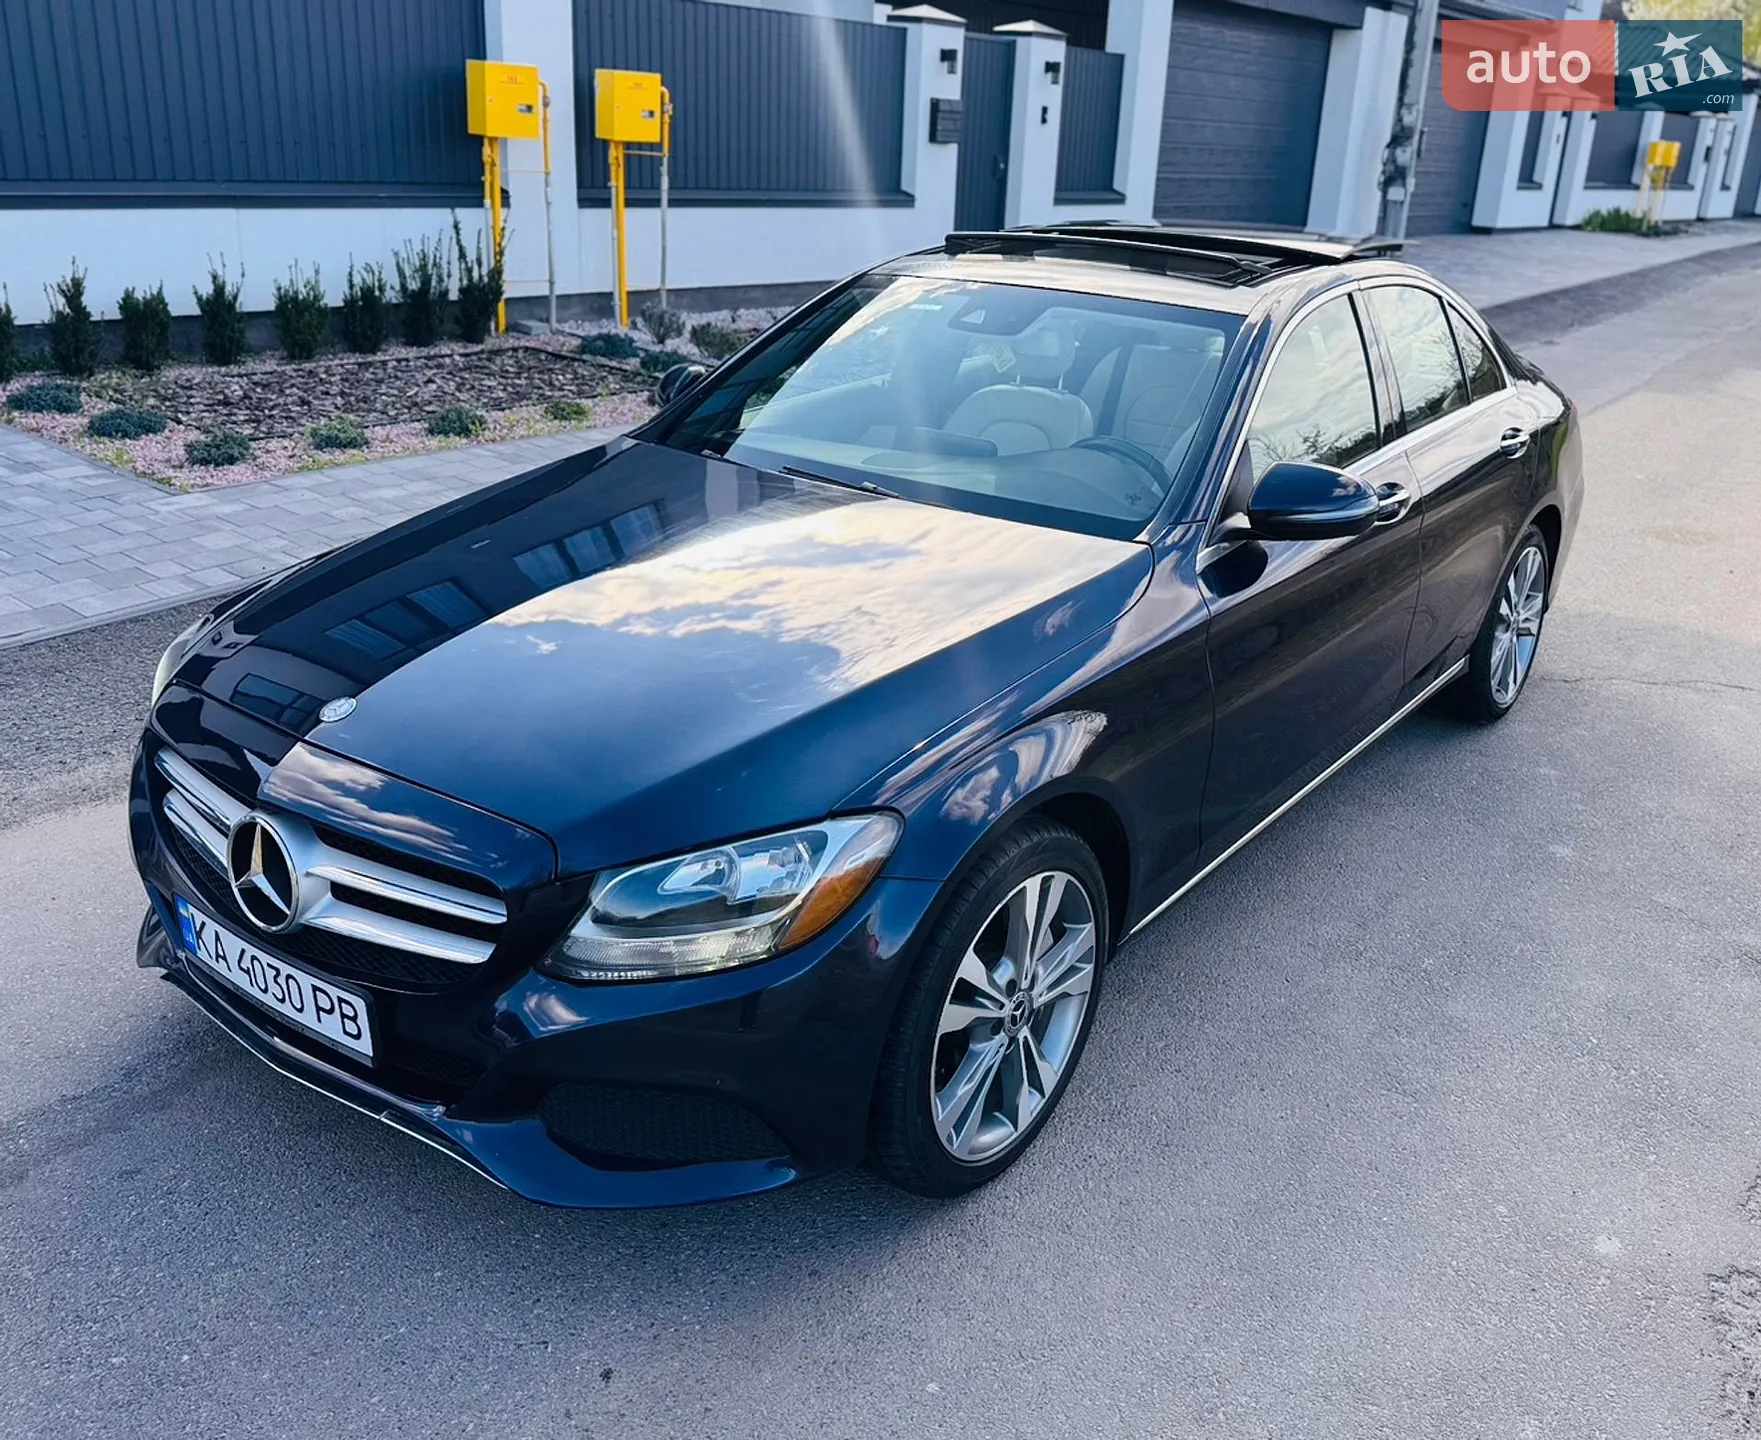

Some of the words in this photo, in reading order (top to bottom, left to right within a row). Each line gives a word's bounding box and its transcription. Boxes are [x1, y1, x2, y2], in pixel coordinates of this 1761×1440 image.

[190, 912, 232, 973] KA
[237, 947, 305, 1014] 4030
[311, 983, 362, 1041] PB
